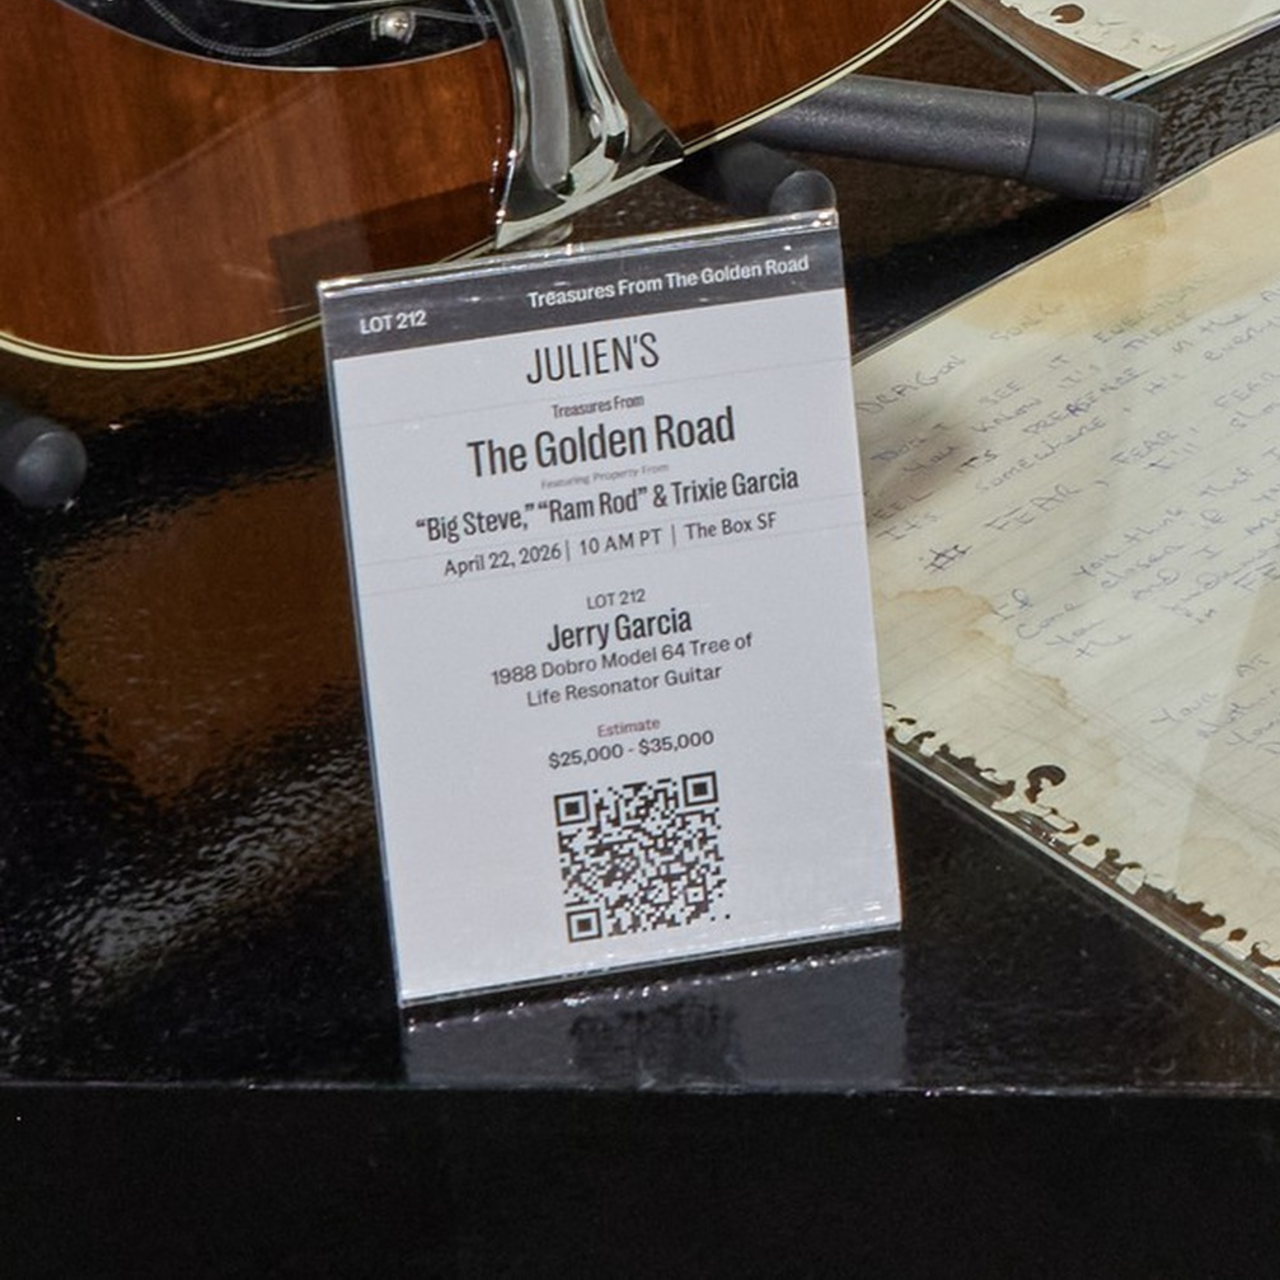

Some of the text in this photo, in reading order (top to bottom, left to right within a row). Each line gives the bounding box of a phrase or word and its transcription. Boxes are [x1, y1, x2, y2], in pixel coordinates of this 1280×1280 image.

[526, 253, 809, 308] Treasures From The Golden Road
[359, 308, 427, 334] LOT 212
[526, 331, 660, 384] JULIEN'S
[466, 404, 735, 477] The Golden Road
[415, 467, 799, 543] “Big Steve,” “Ram Rod” & Trixie Garcia
[444, 511, 776, 578] April 22, 2026 10 AM PT The Box SF
[586, 588, 645, 610] LOT 212
[546, 607, 693, 652] Jerry Garcia
[491, 631, 752, 685] 1988 Dobro Model 64 Tree of
[526, 666, 722, 707] Life Resonator Guitar
[548, 743, 624, 770] $25,000
[637, 729, 714, 756] $35,000
[596, 718, 661, 738] Estimate
